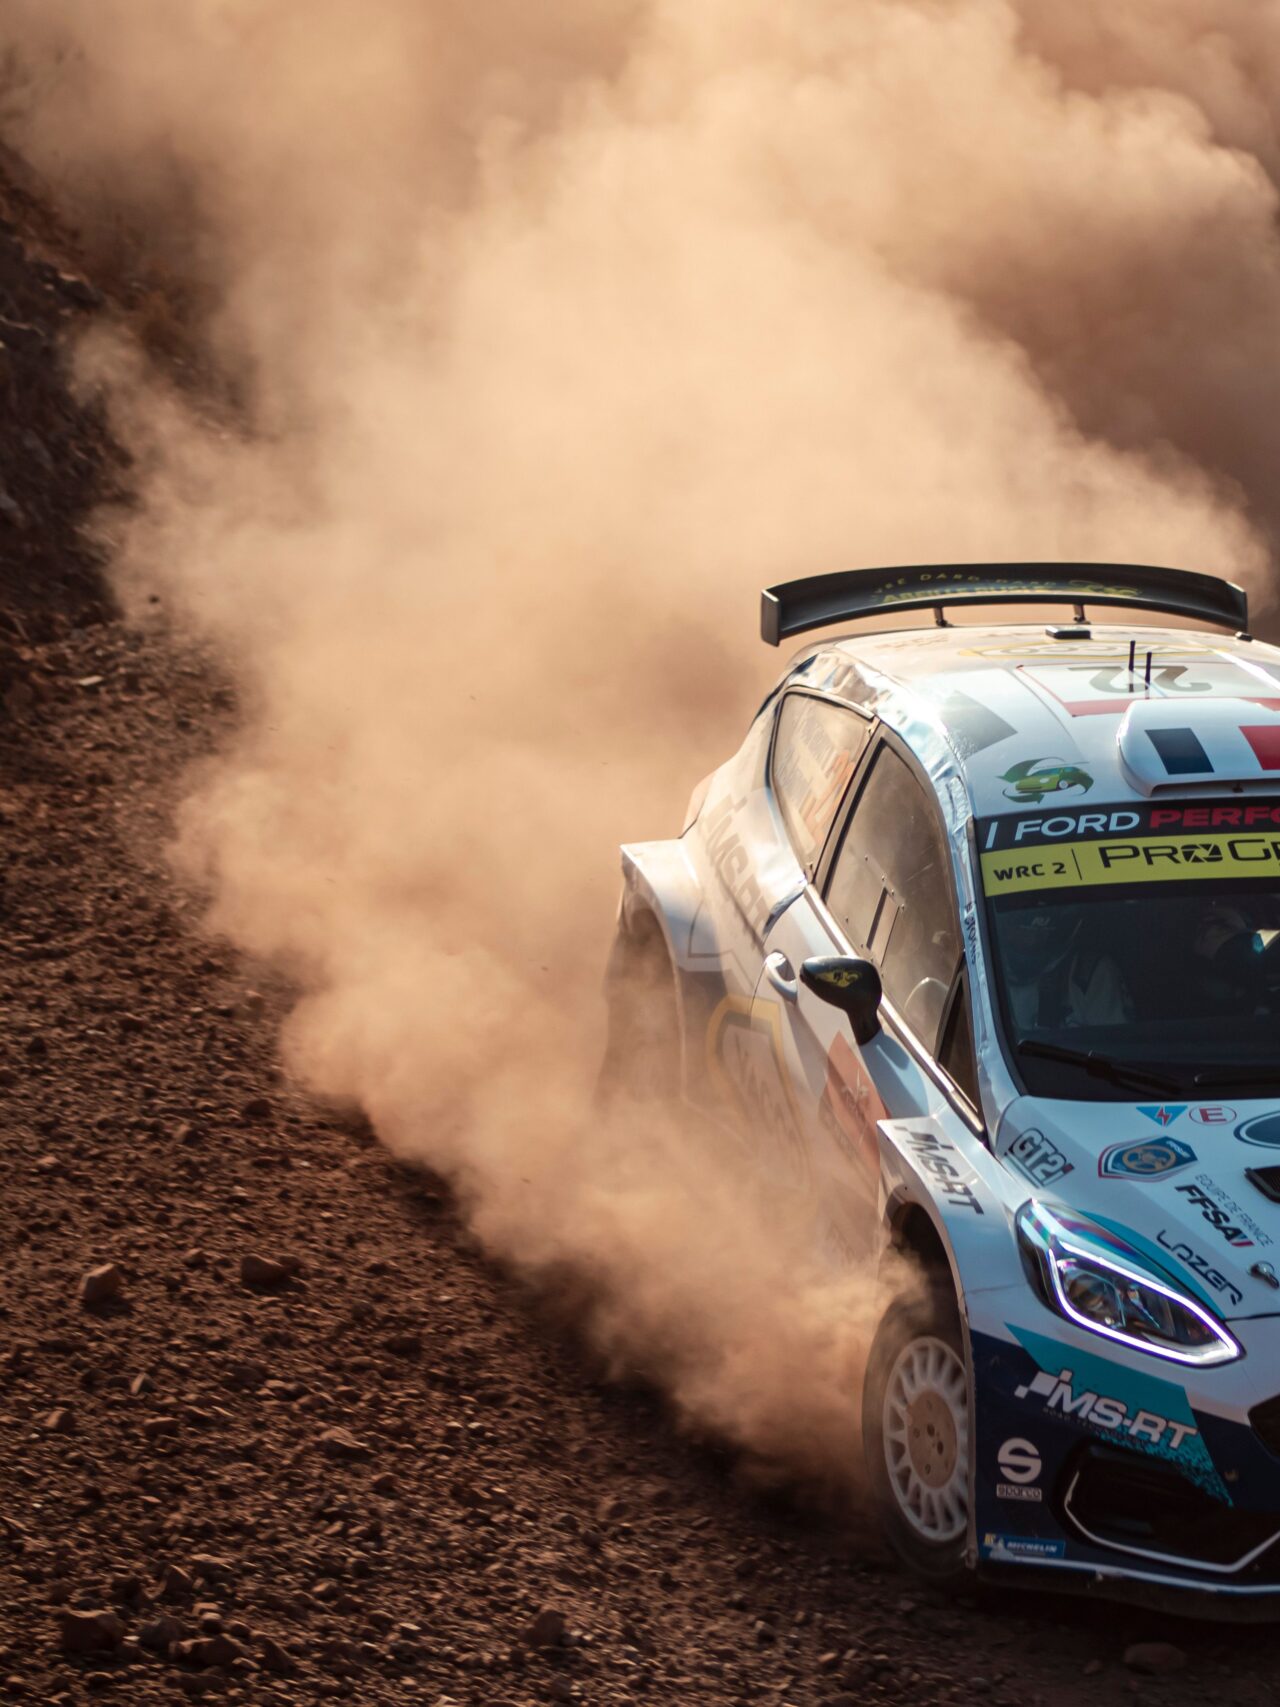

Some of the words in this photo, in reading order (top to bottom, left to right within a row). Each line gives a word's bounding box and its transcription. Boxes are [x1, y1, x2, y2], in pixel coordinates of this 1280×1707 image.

[1069, 665, 1212, 693] 22
[1014, 811, 1141, 840] FORD
[993, 862, 1050, 882] WRC
[1053, 861, 1067, 876] 2
[1174, 1183, 1244, 1242] FFSA
[1236, 1212, 1274, 1249] FRANCE
